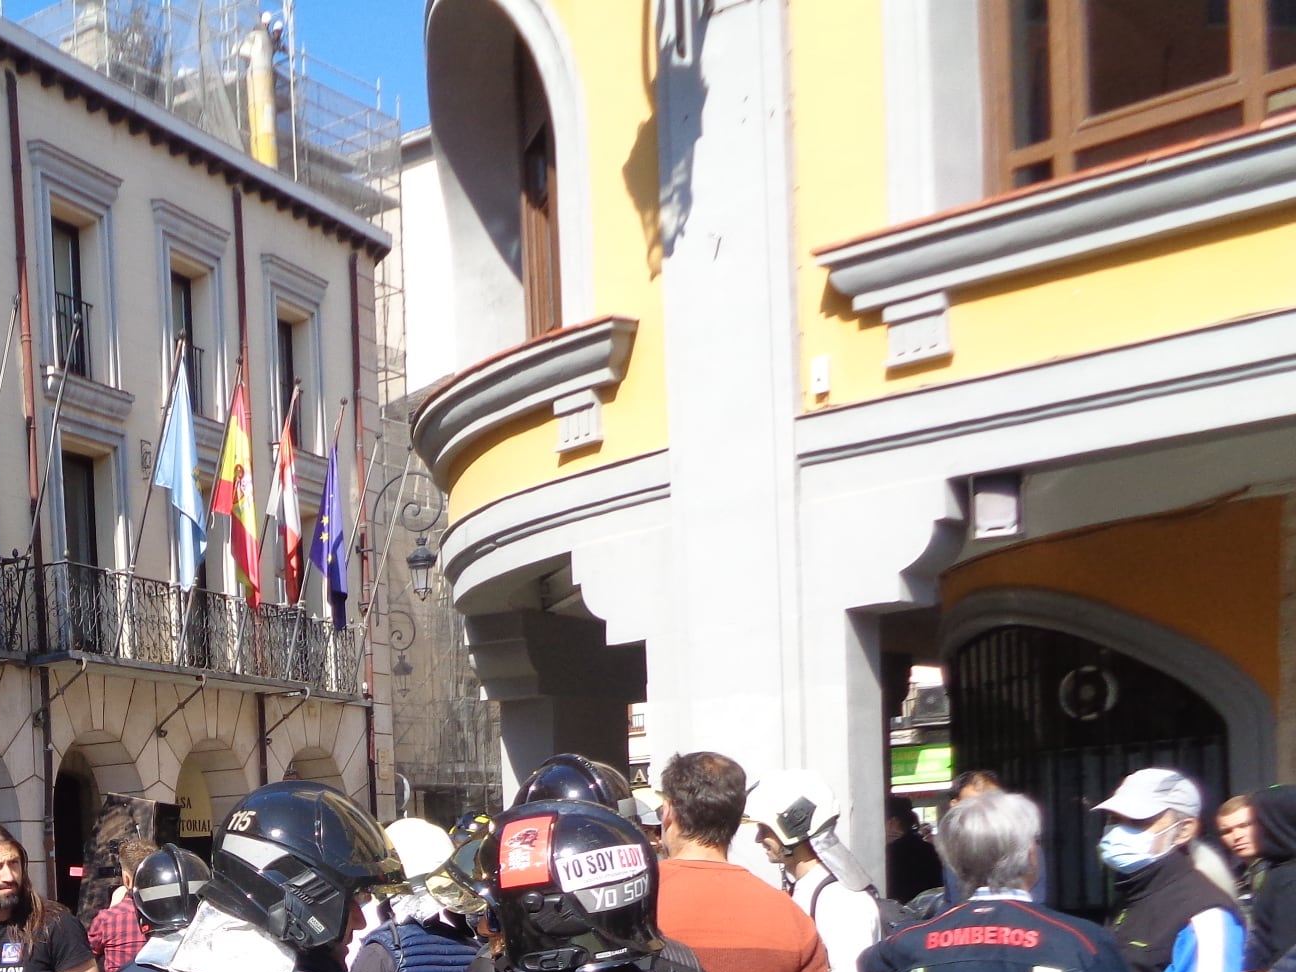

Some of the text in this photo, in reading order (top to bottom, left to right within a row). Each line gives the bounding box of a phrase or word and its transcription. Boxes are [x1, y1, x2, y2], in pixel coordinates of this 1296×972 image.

[227, 811, 257, 831] 115
[563, 859, 583, 881] YO
[586, 850, 614, 875] SOY
[617, 847, 642, 868] ELOY
[590, 887, 617, 910] YO
[926, 926, 1040, 949] BOMBEROS
